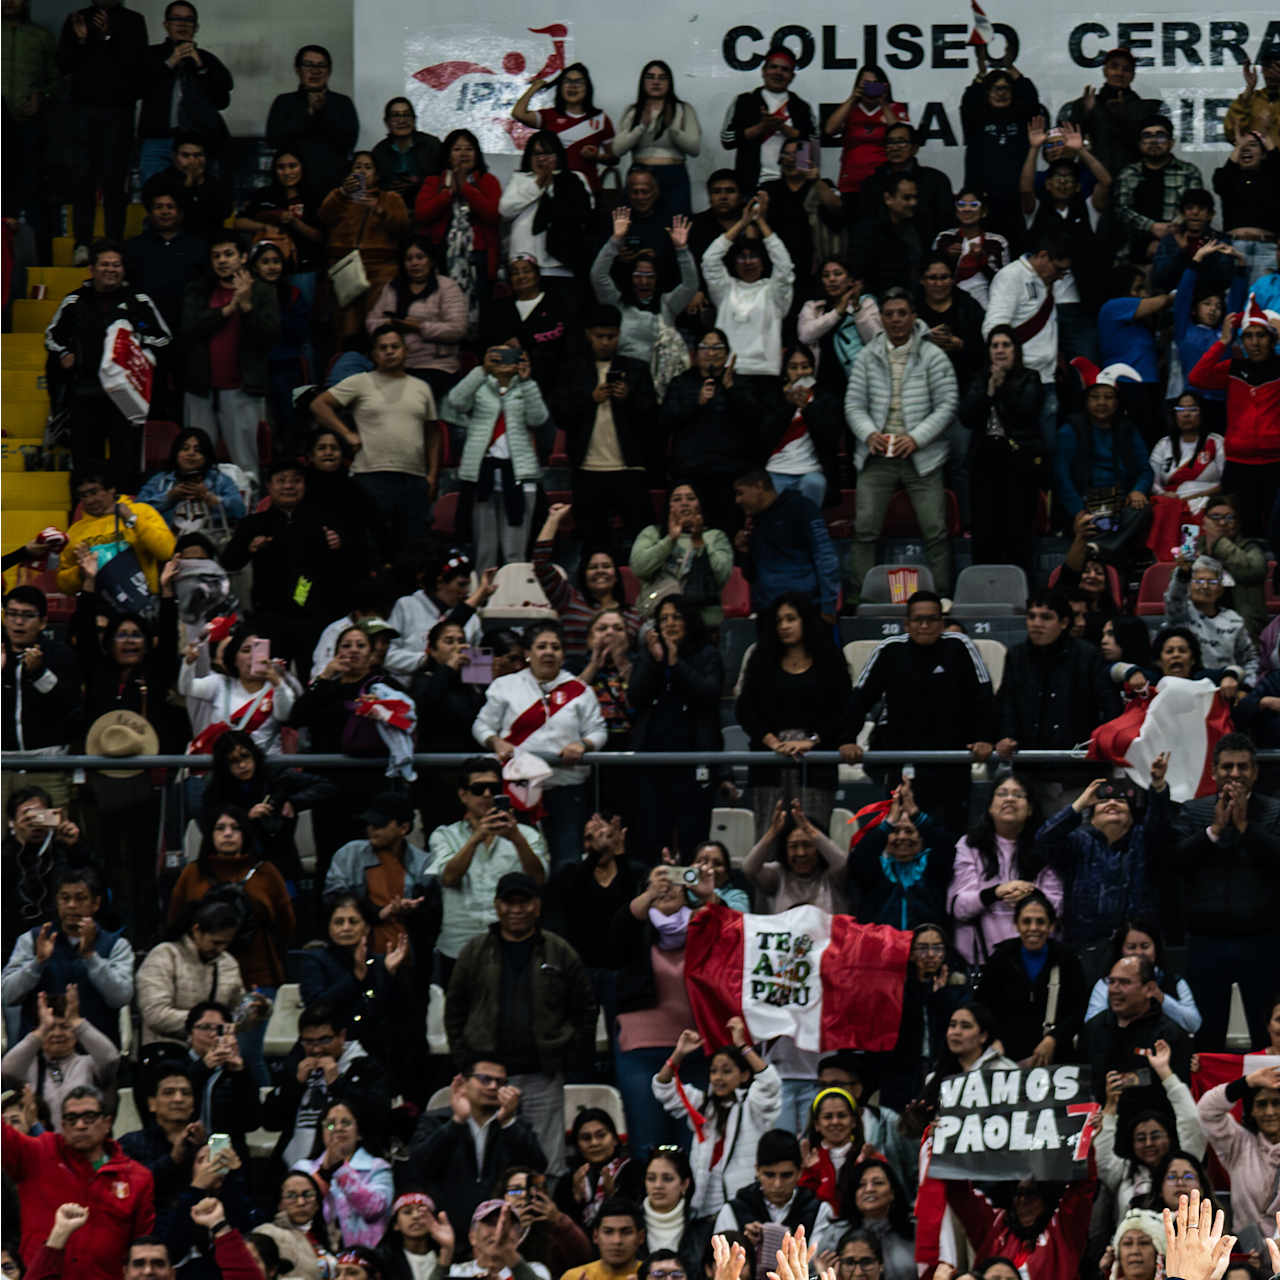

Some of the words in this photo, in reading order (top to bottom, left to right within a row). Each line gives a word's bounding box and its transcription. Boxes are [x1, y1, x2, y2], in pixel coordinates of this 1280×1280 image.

[722, 23, 1020, 71] COLISEO
[757, 931, 791, 953] TE
[940, 1065, 1061, 1108] VAMOS
[930, 1107, 1063, 1156] PAOLA
